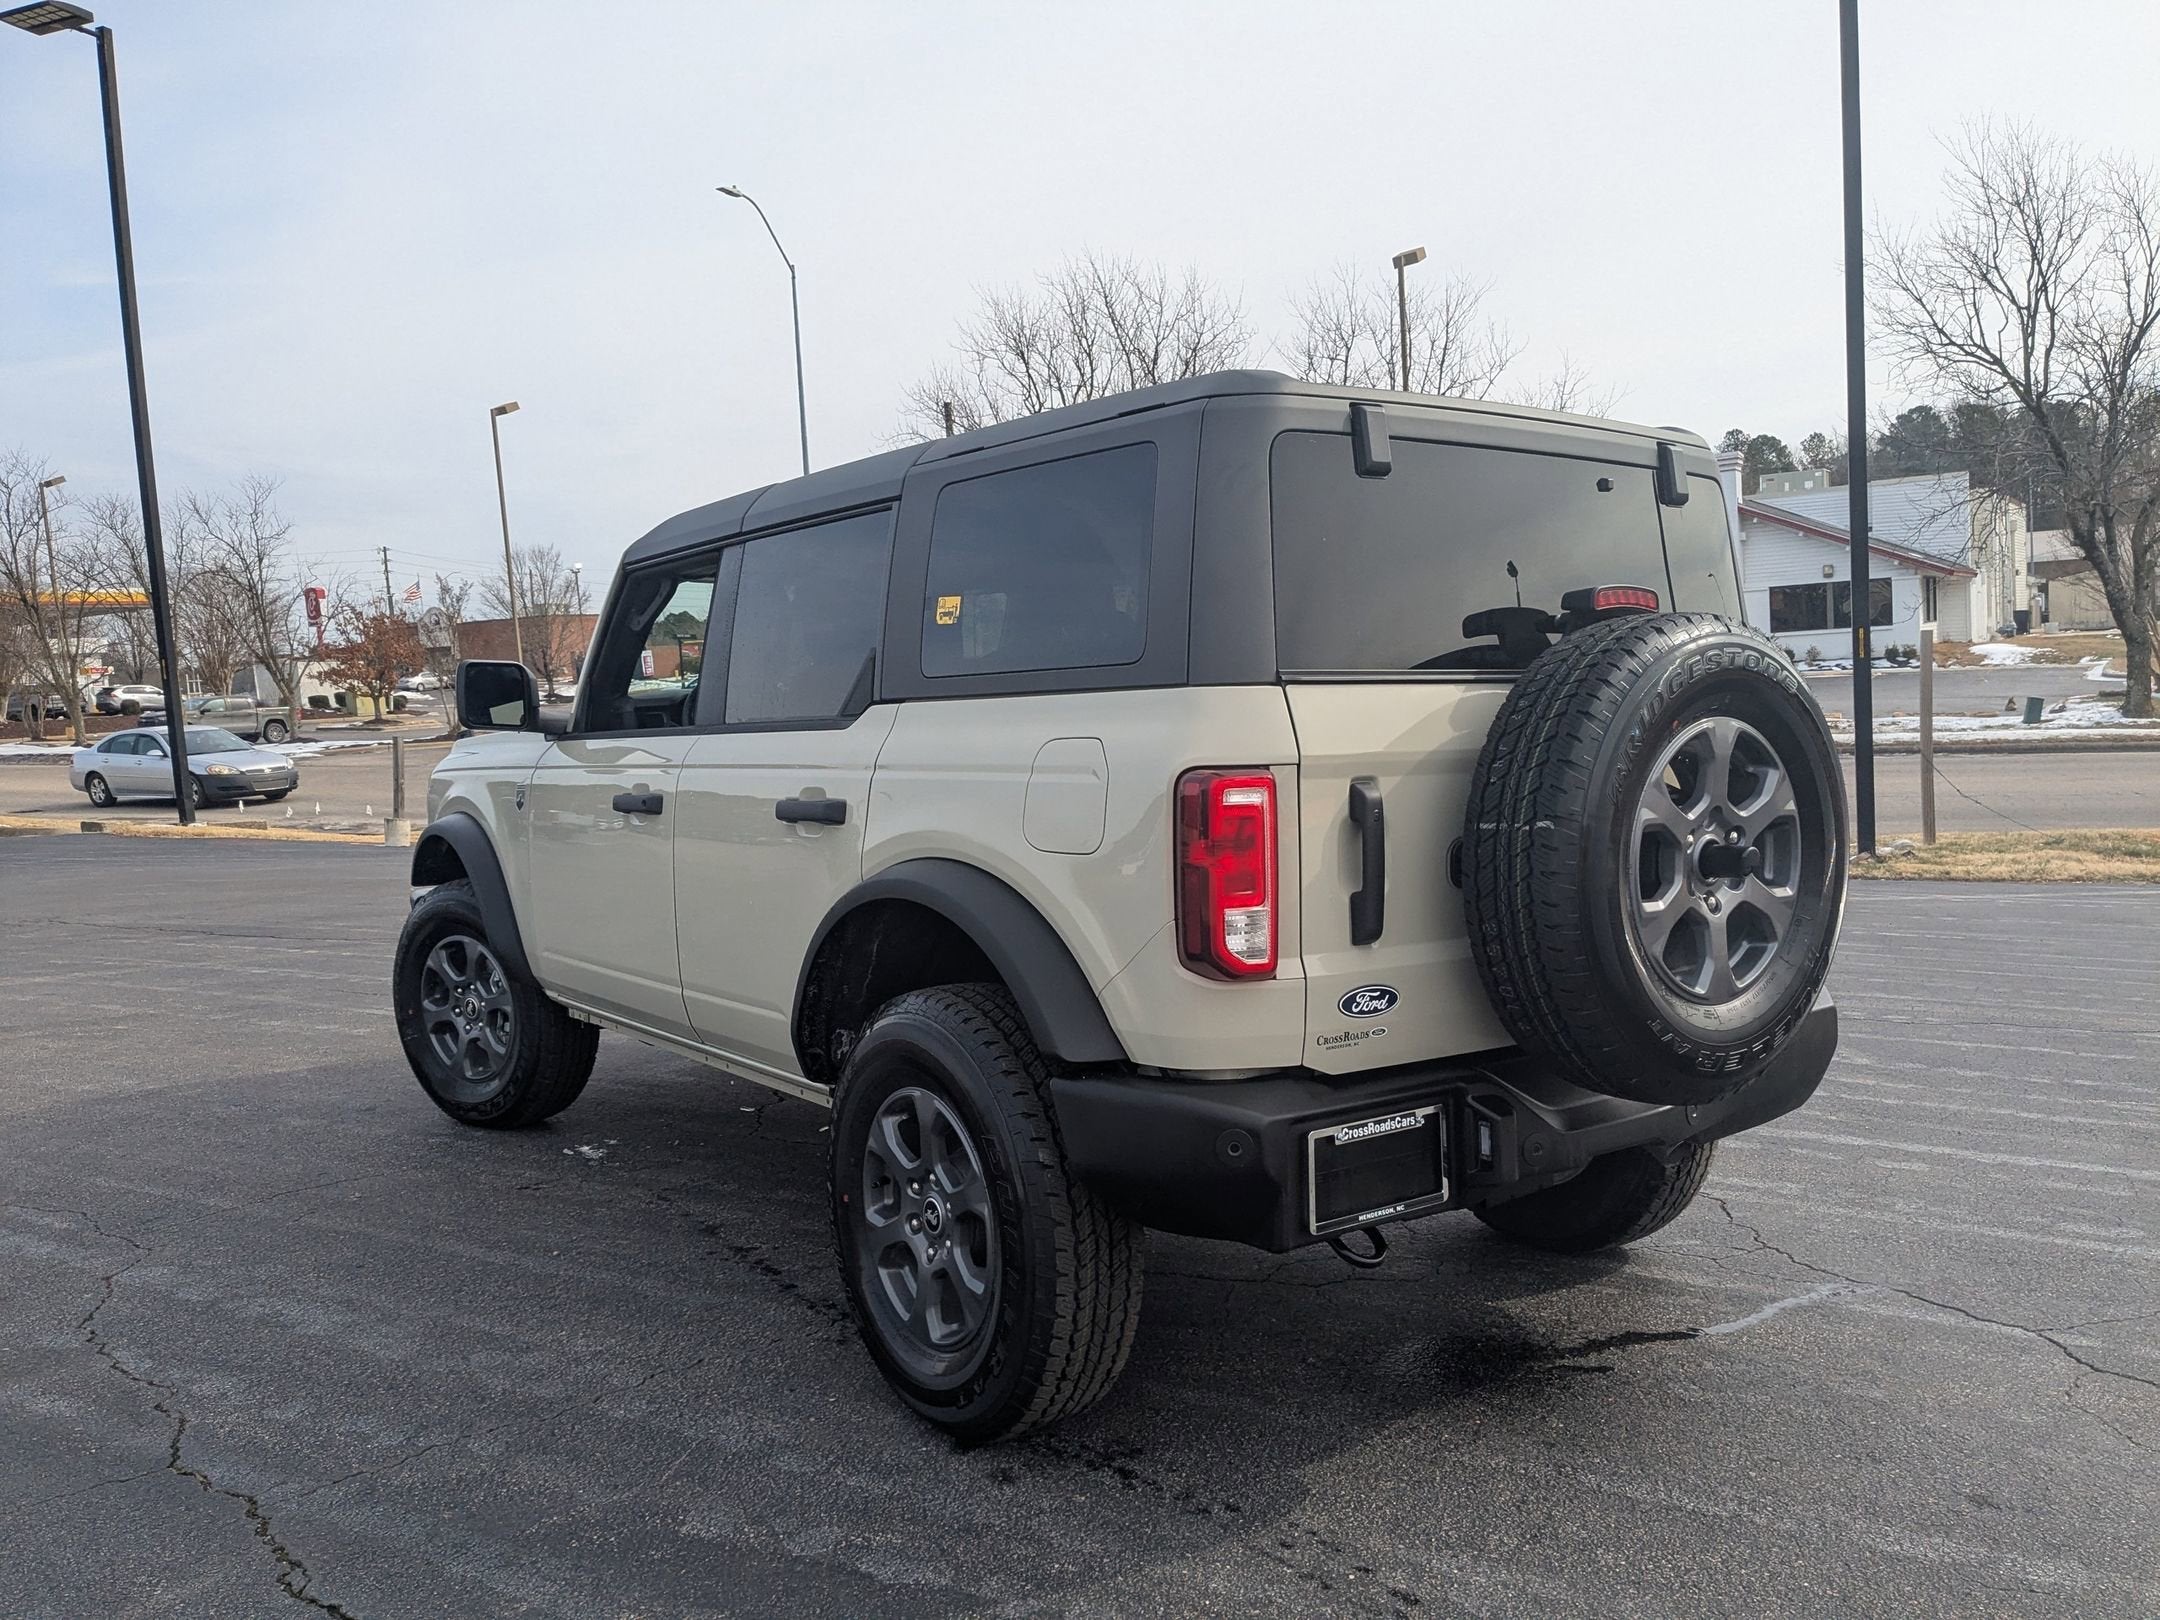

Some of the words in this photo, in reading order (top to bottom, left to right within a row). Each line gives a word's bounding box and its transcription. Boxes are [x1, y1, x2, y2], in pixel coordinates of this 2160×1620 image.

[1608, 647, 1799, 804] BRIDGESTONE
[1351, 991, 1389, 1012] Ford
[1342, 1116, 1416, 1141] CrossRoadsCars
[1396, 1204, 1405, 1212] NC
